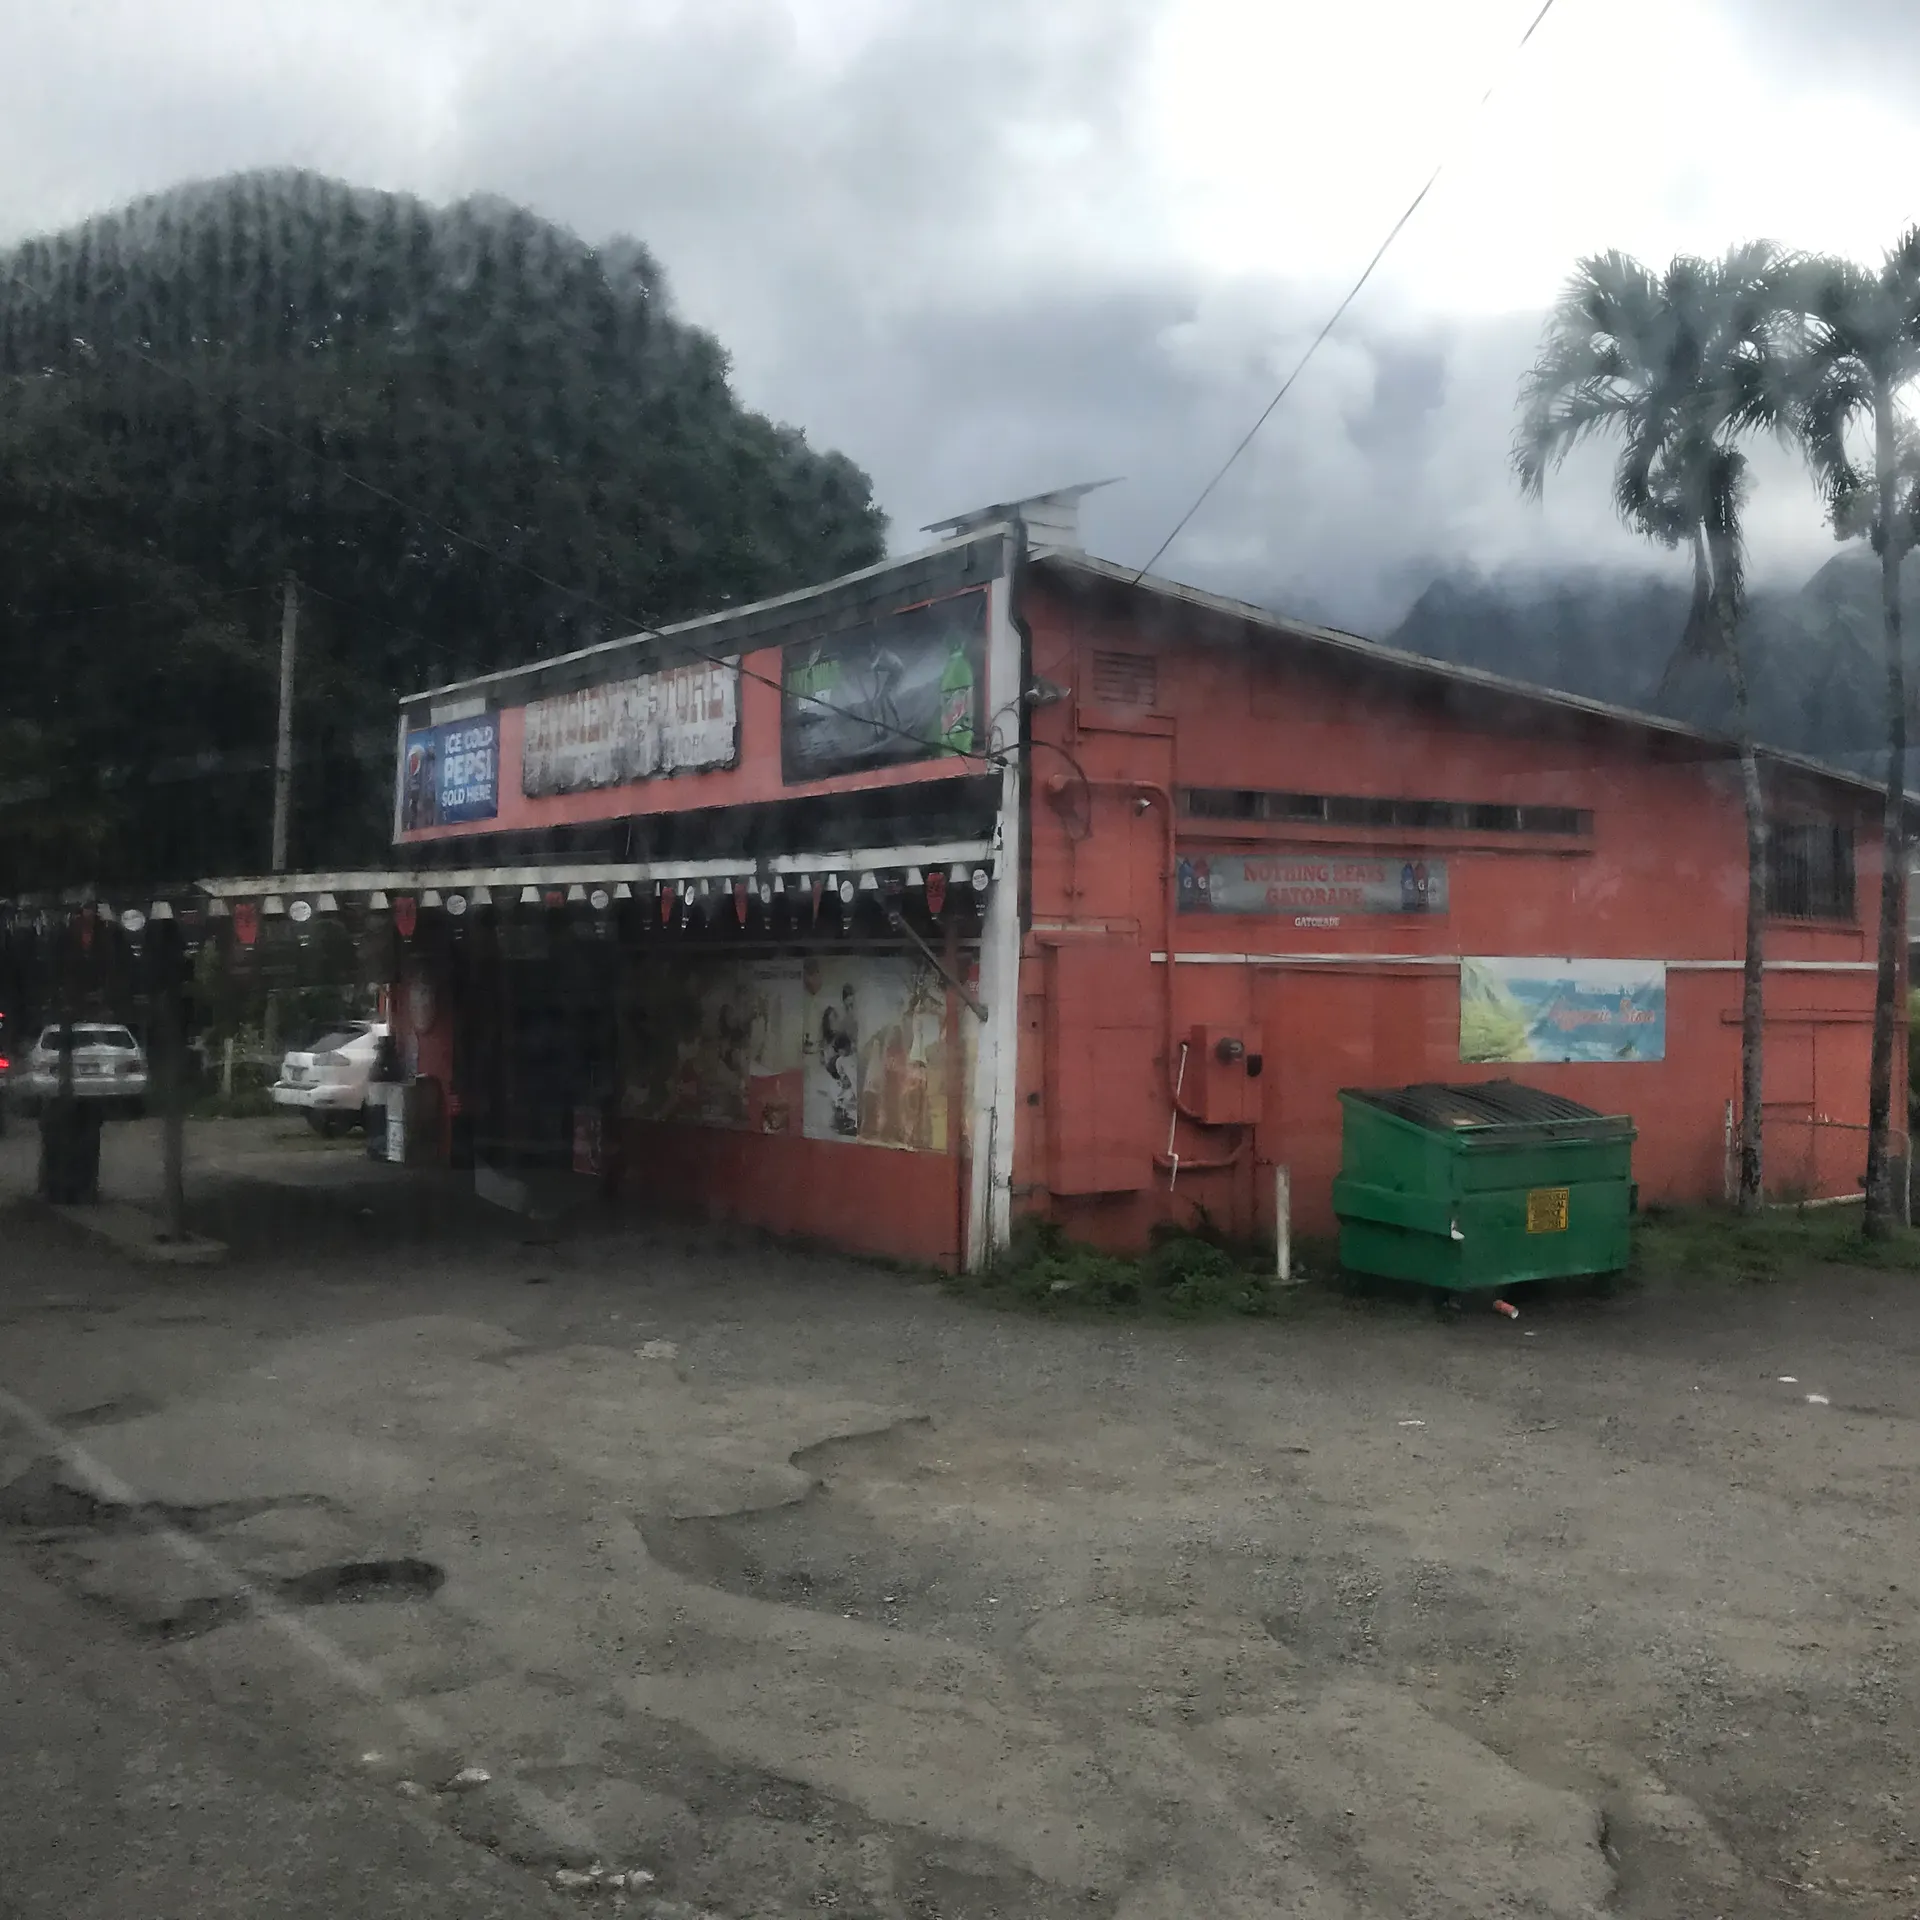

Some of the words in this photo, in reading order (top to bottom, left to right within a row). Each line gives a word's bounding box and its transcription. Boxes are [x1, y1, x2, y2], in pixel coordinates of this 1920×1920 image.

[445, 732, 462, 754] ICE
[463, 726, 493, 750] COLD
[444, 748, 492, 787] PEPSI
[442, 788, 465, 807] SOLD
[466, 783, 492, 803] HERE
[1243, 861, 1328, 882] NOTHING
